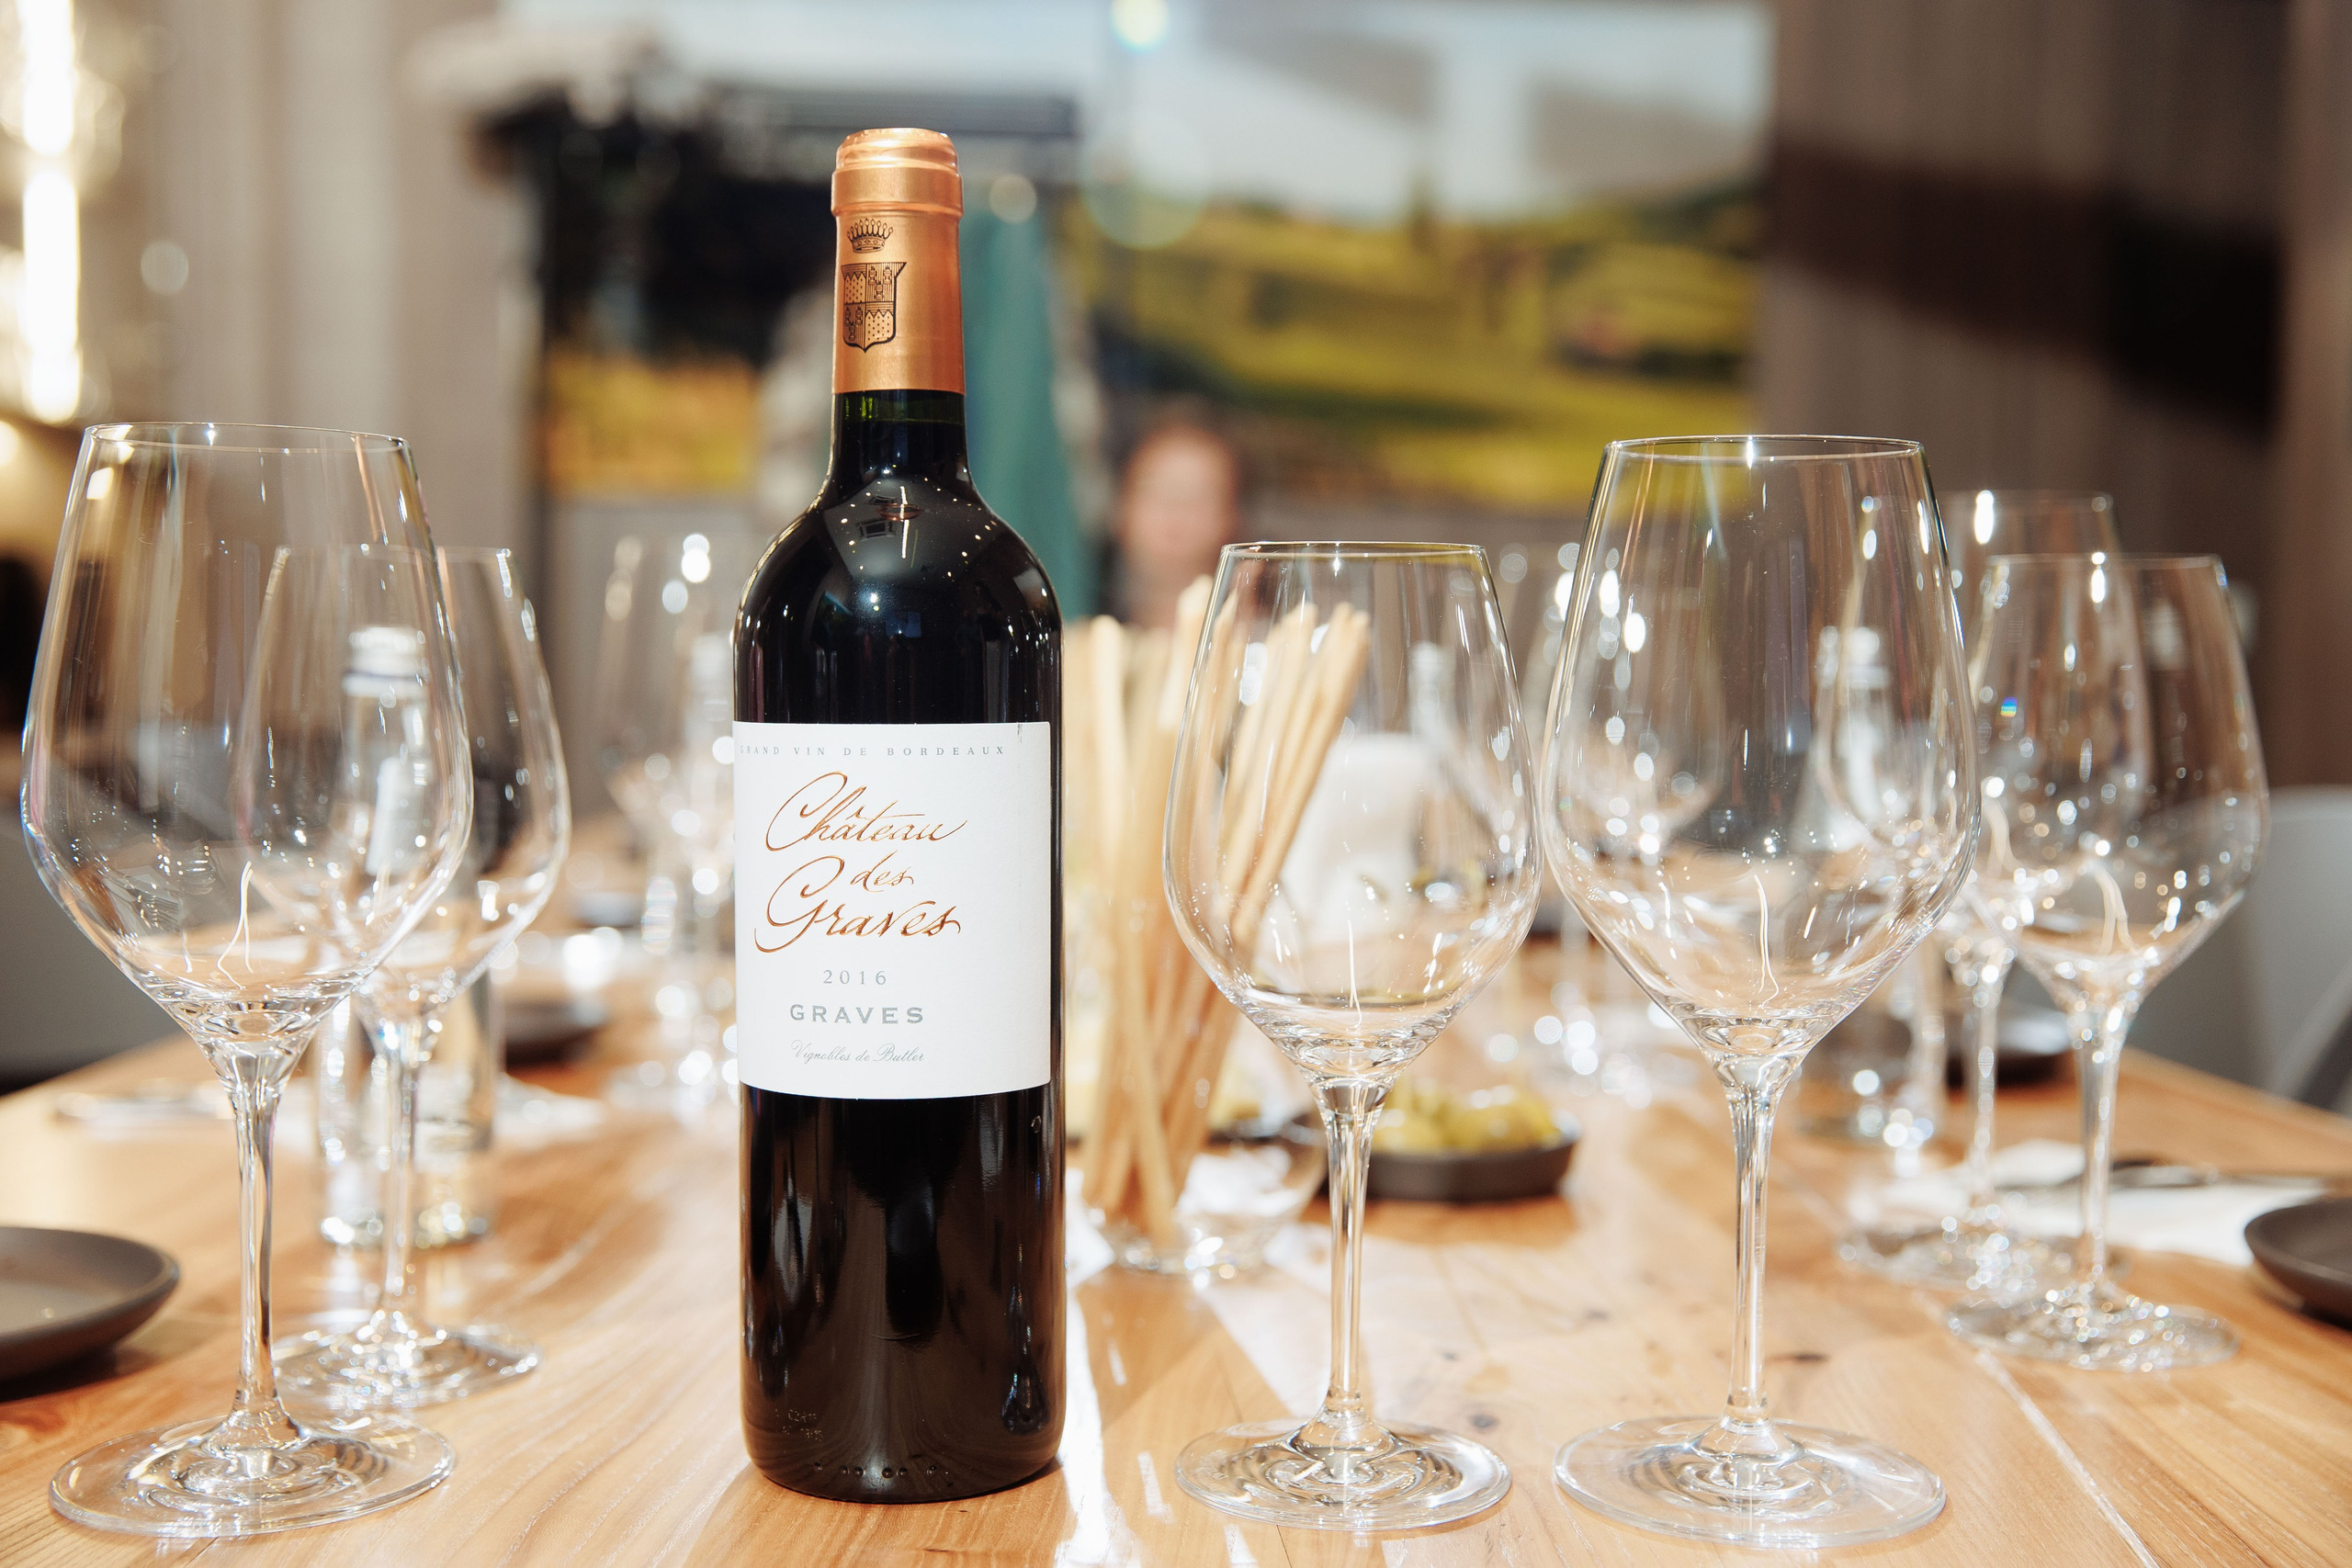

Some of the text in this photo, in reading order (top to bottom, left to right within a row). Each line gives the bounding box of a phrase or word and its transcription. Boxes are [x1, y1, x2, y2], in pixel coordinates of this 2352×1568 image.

[740, 745, 1004, 756] GRAND VIN DE BORDEAUX
[764, 771, 967, 852] Château
[850, 850, 914, 893] des
[754, 855, 961, 953] Graves
[822, 969, 887, 986] 2016
[789, 1003, 923, 1024] GRAVES
[790, 1039, 924, 1065] Vignobles de Butler
